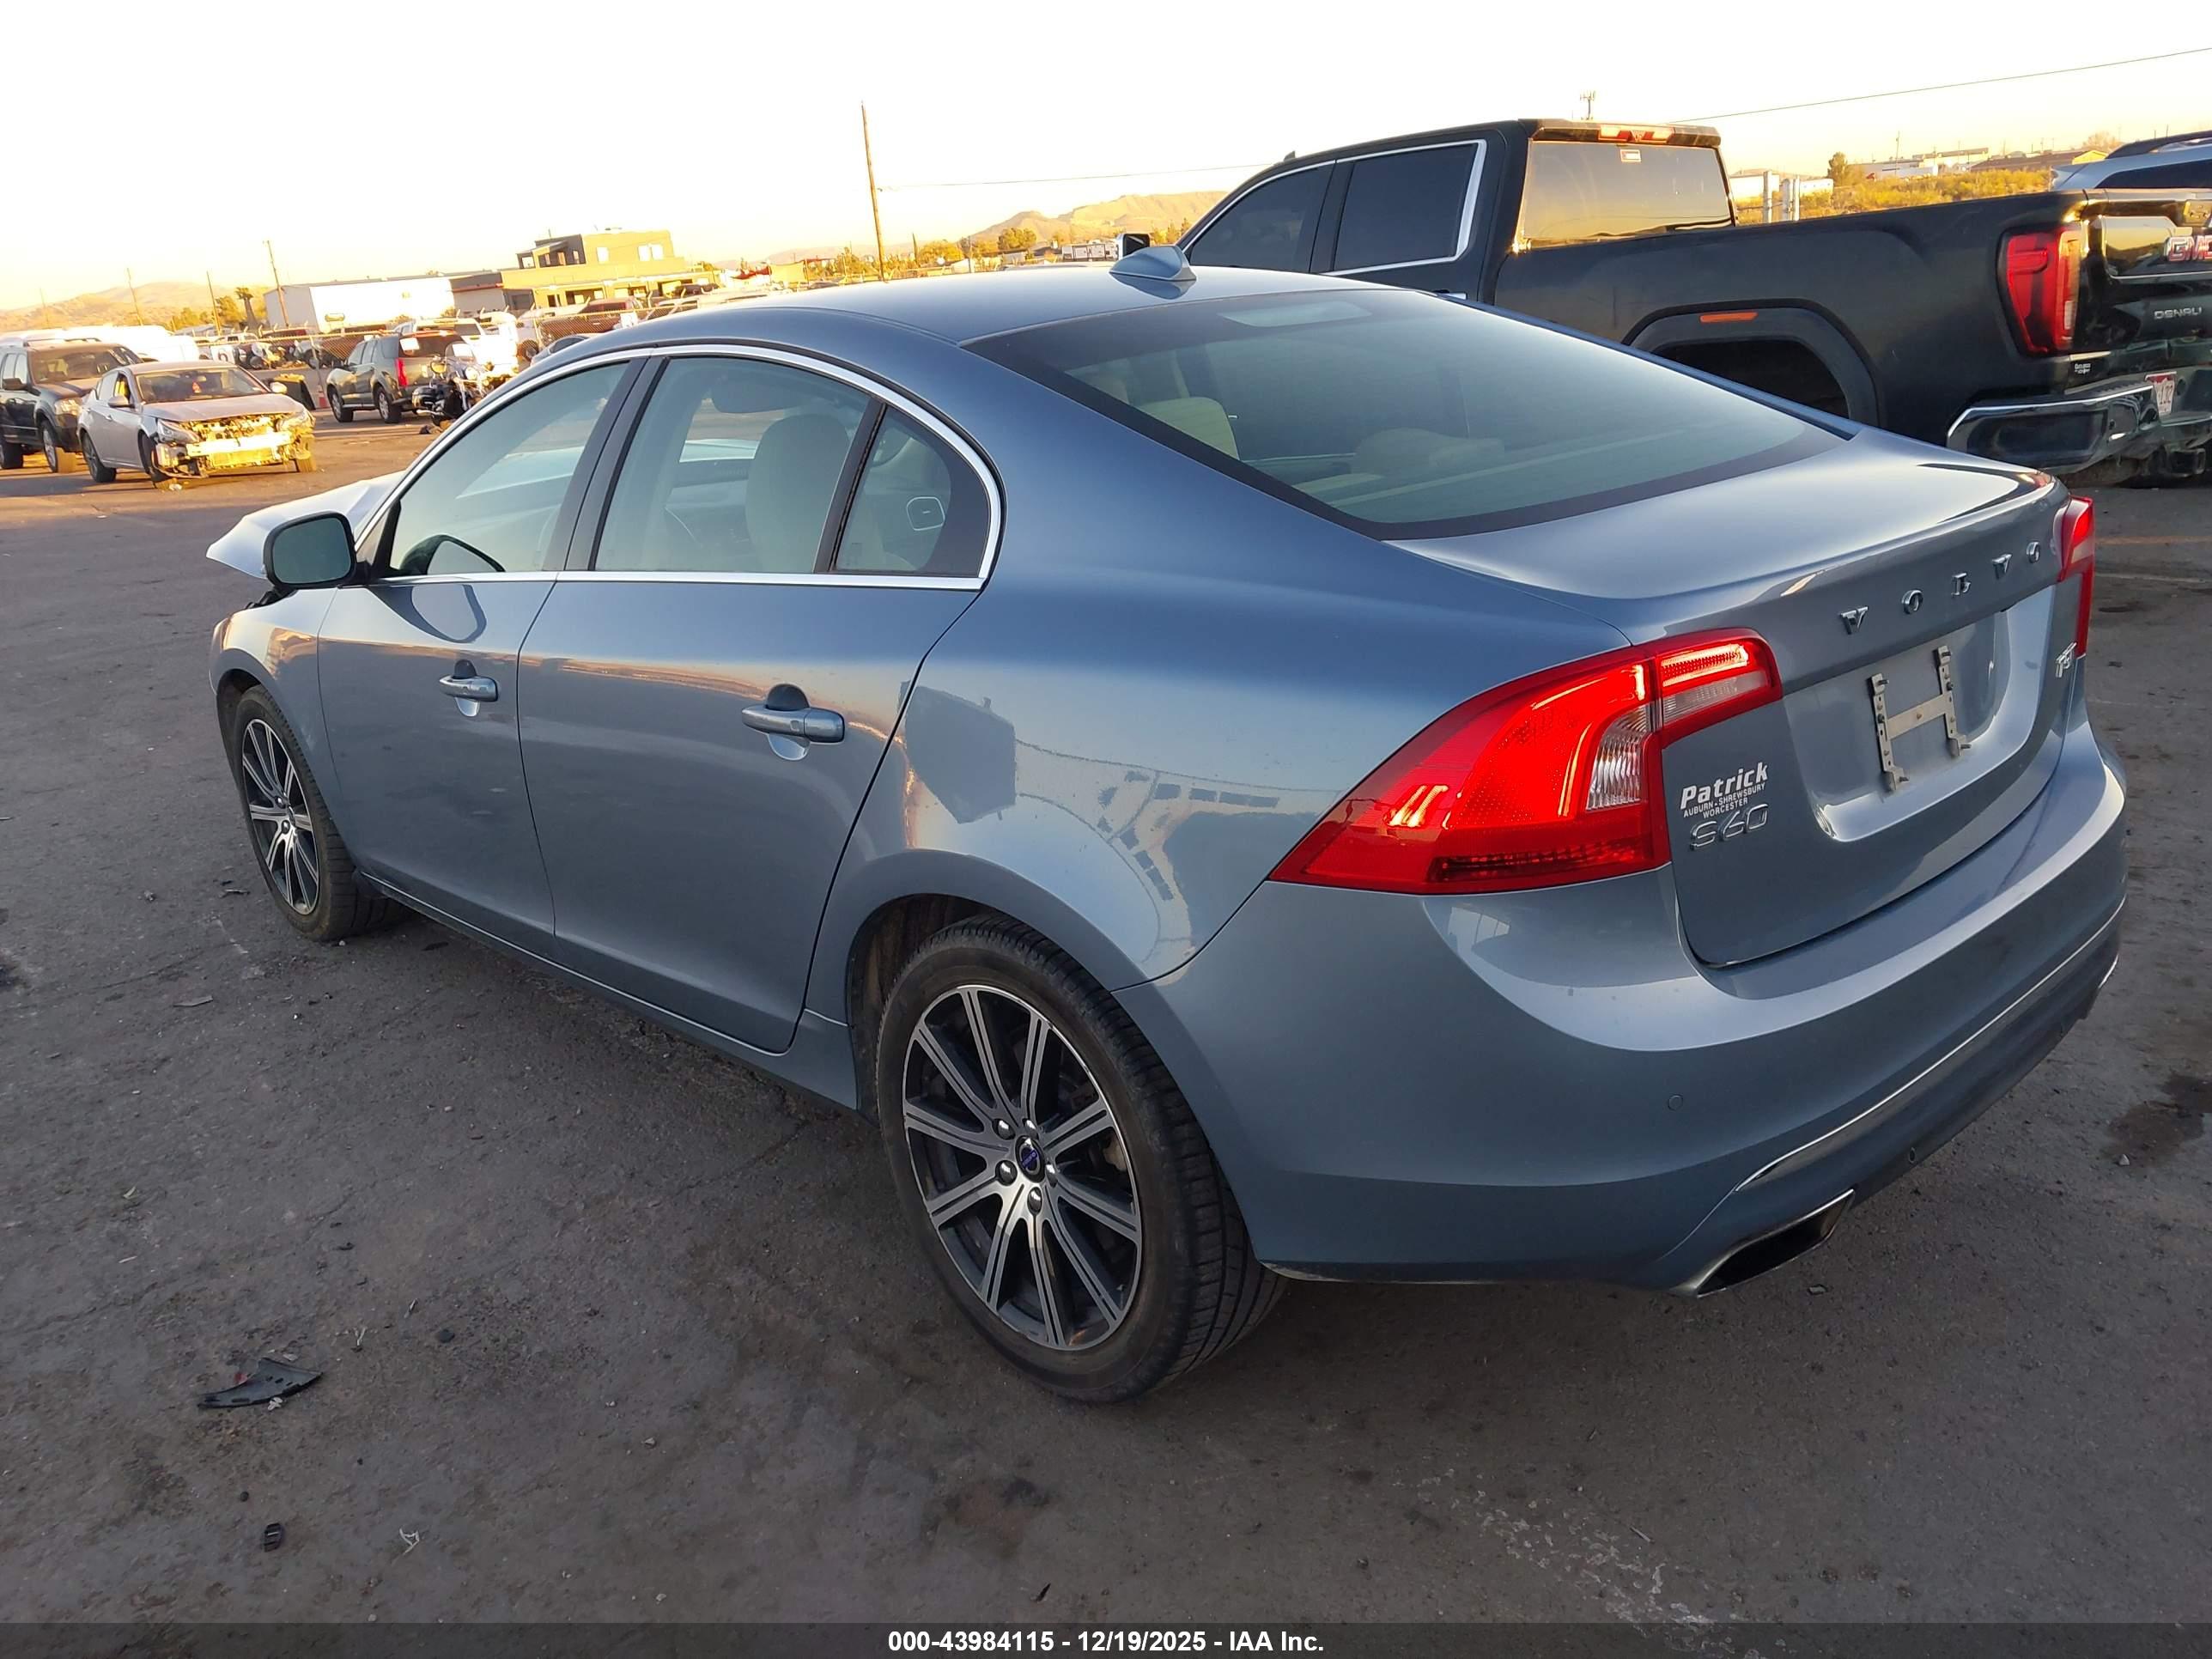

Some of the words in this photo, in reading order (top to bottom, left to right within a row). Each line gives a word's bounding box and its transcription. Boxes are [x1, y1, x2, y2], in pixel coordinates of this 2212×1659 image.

[2154, 307, 2203, 320] DENALI
[1838, 540, 2042, 635] VOLVO
[1680, 762, 1768, 810] Patrick
[1683, 800, 1714, 818] AUBURN
[1718, 782, 1765, 806] SHREWSBURY
[1689, 803, 1769, 851] S60
[1702, 797, 1748, 819] WORCESTER
